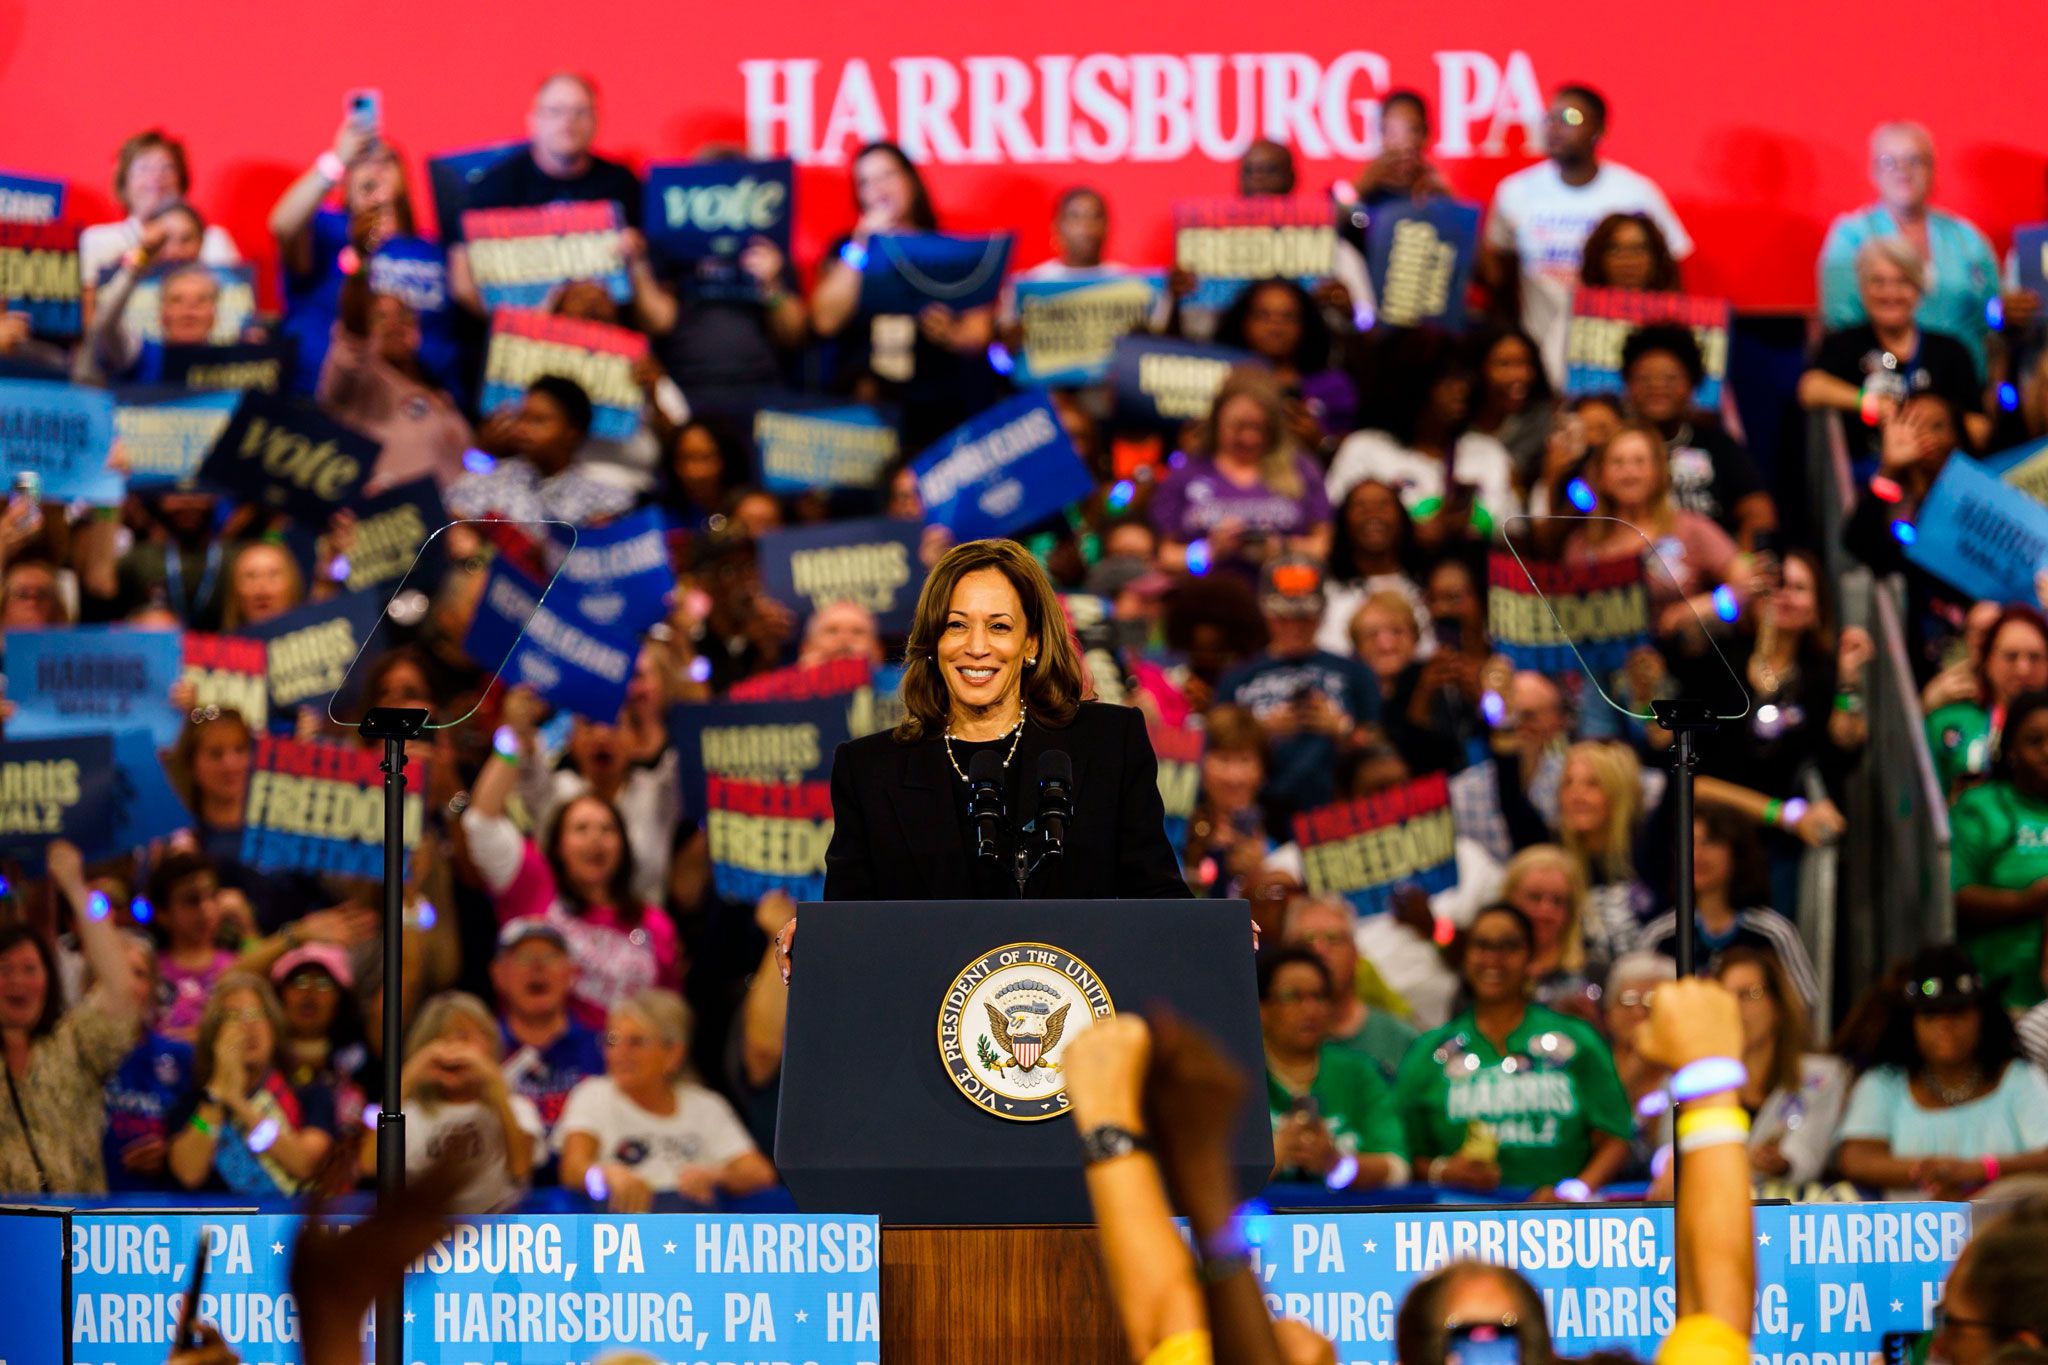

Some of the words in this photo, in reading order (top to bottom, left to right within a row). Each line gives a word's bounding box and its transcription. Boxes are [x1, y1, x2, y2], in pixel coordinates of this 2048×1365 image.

[1433, 50, 1543, 157] PA
[663, 177, 786, 232] vote
[239, 417, 360, 499] vote
[999, 950, 1020, 966] OF
[1027, 950, 1058, 967] THE
[942, 959, 992, 1063] PRESIDENT
[1065, 960, 1110, 1020] UNITE
[956, 1067, 997, 1109] VICE
[204, 1224, 253, 1274] PA
[593, 1223, 645, 1274] PA
[695, 1223, 879, 1274] HARRISB
[1293, 1223, 1345, 1274] PA
[1395, 1216, 1672, 1276] HARRISBURG,
[434, 1292, 709, 1350] HARRISBURG,
[725, 1292, 776, 1343] PA
[1819, 1282, 1872, 1333] PA
